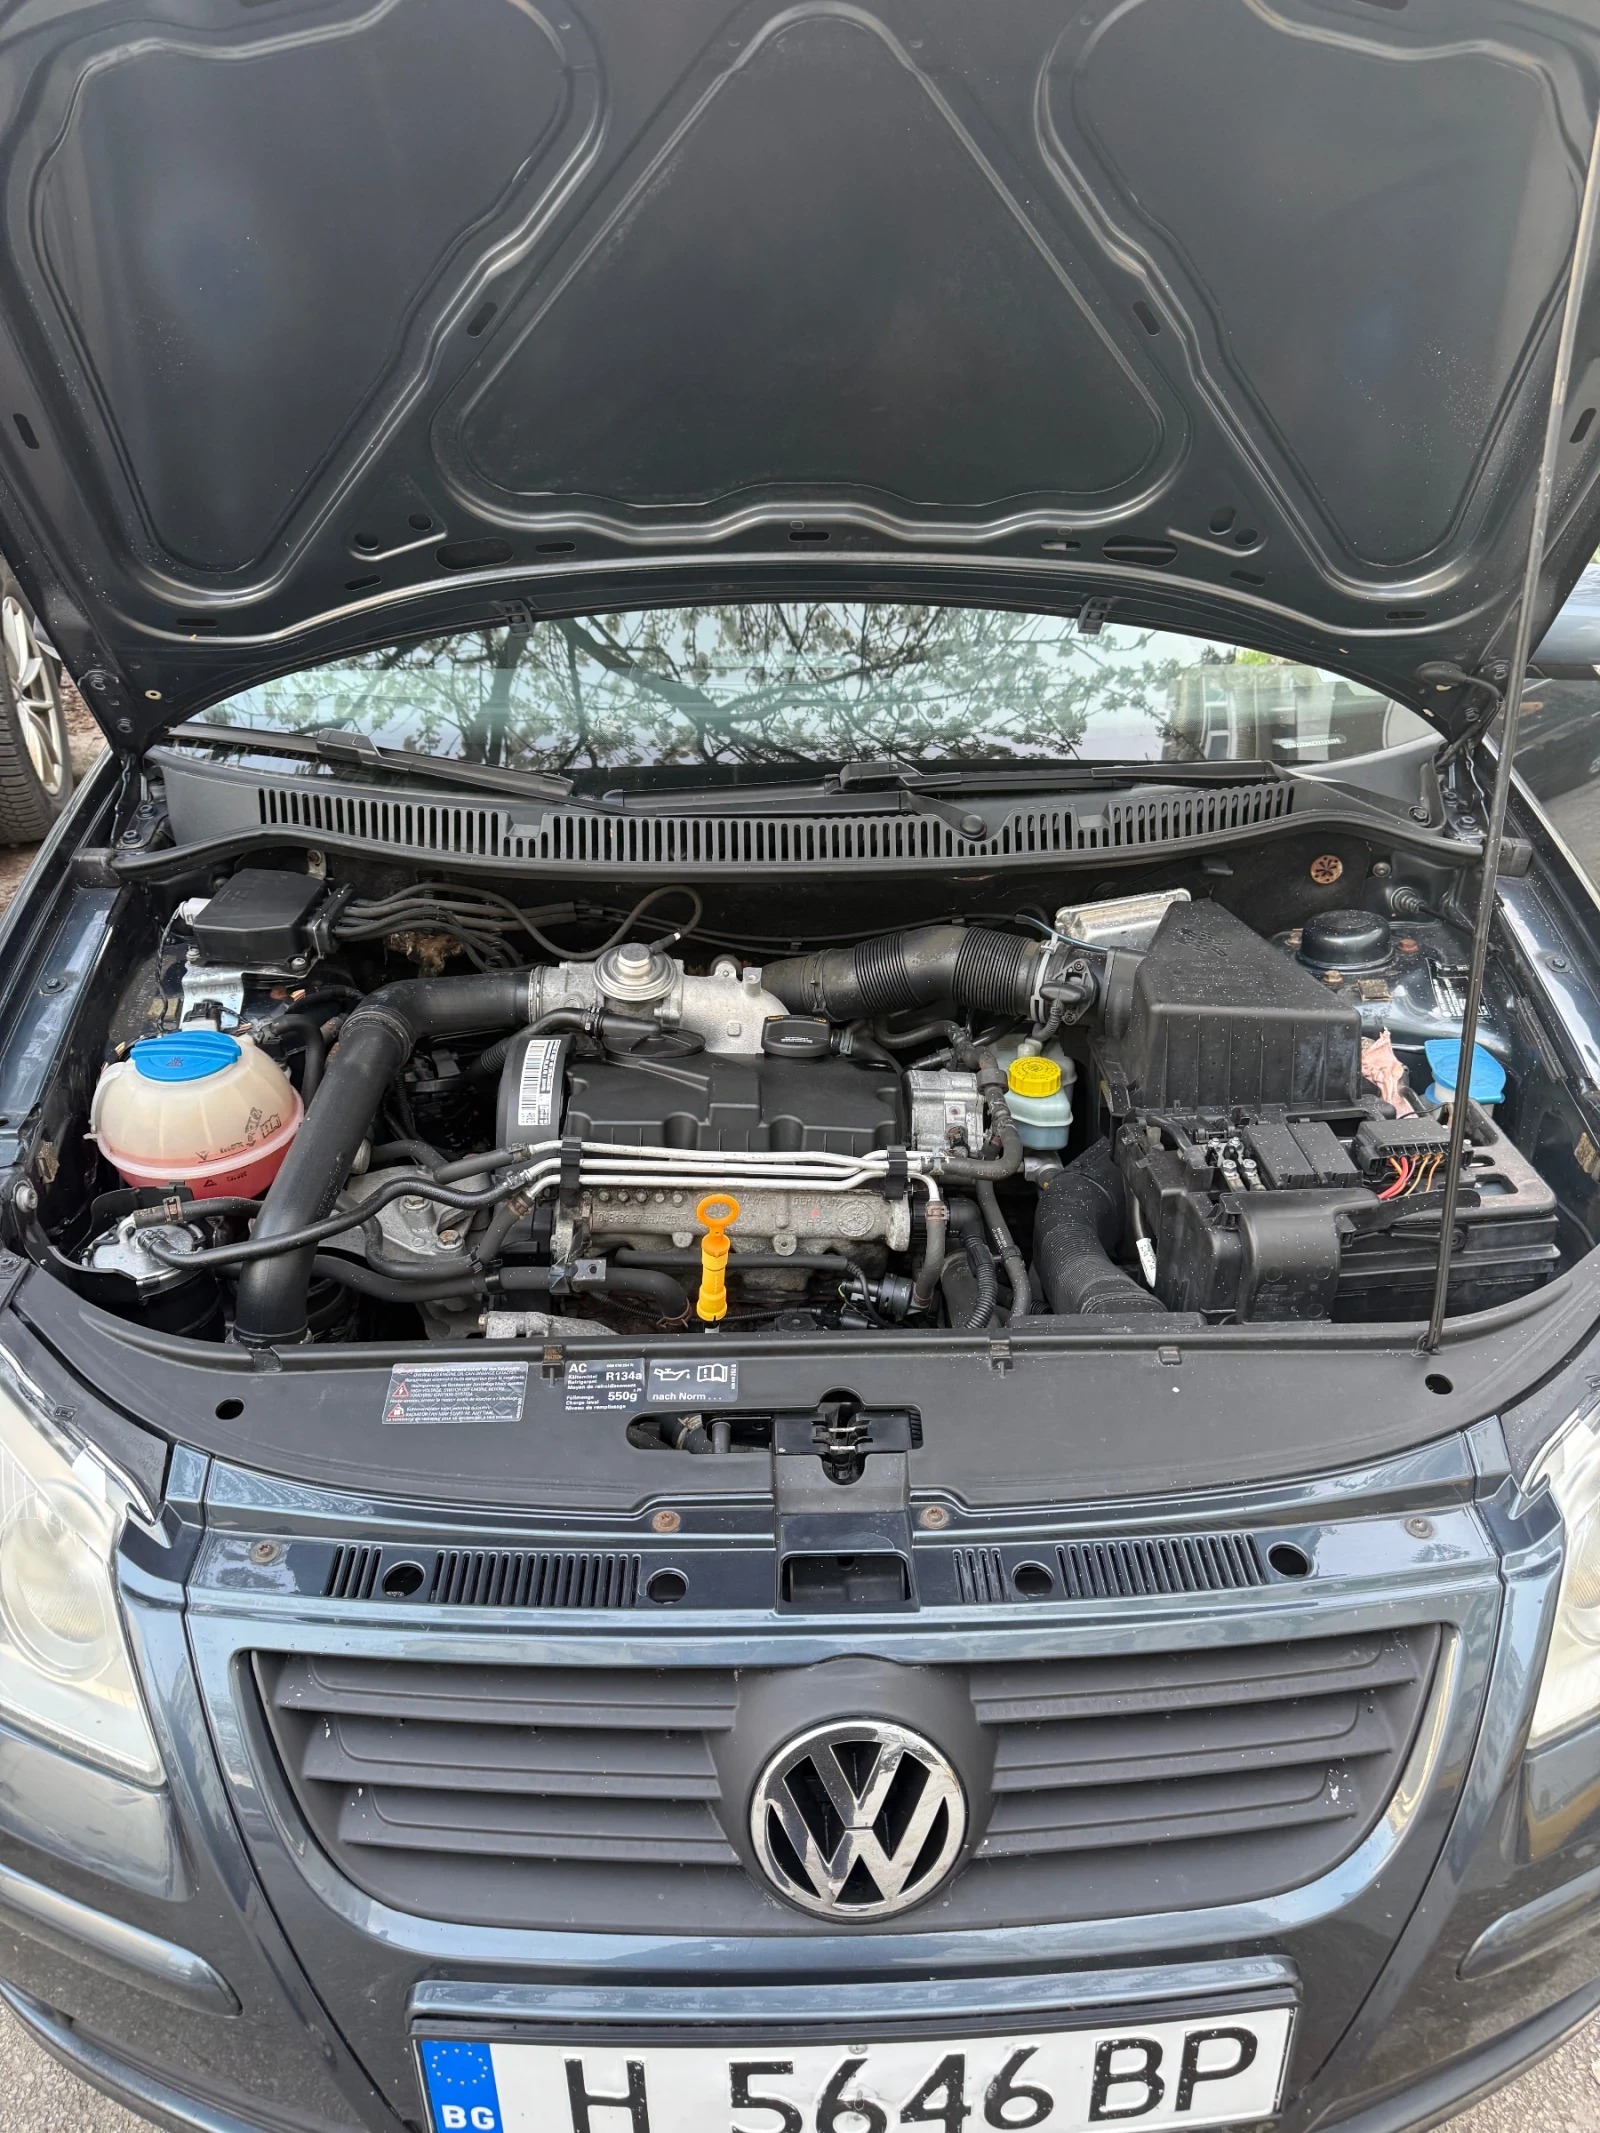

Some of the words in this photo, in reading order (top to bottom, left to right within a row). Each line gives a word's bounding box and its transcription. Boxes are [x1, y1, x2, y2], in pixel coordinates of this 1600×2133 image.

[569, 1362, 588, 1373] AC
[605, 1371, 643, 1381] R134a
[607, 1391, 638, 1403] 550g
[652, 1392, 676, 1400] nach
[678, 1392, 706, 1400] Norm
[751, 1720, 966, 1917] VW
[564, 2058, 650, 2133] H
[728, 2046, 1054, 2133] 5646
[1087, 2026, 1258, 2122] BP
[441, 2104, 495, 2130] BG
